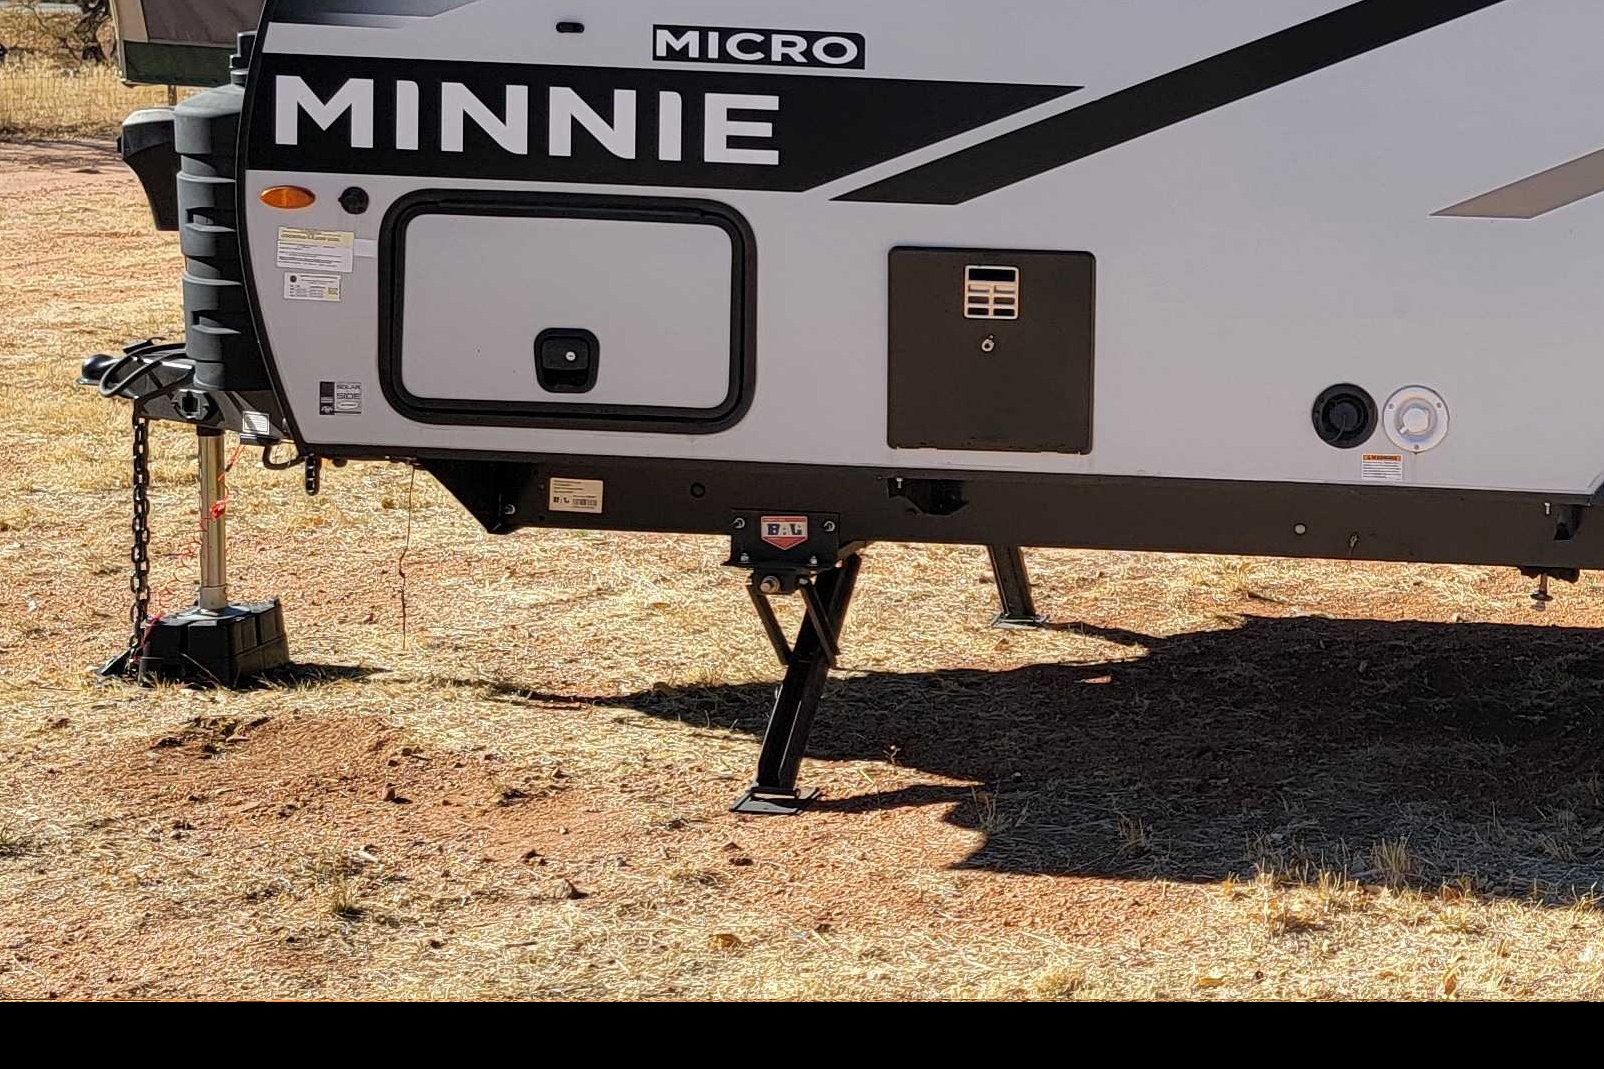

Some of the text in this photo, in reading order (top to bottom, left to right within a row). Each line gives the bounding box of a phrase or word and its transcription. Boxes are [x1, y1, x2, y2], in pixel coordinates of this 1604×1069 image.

[655, 29, 858, 66] MICRO
[275, 74, 780, 165] MINNIE
[336, 392, 361, 400] SIDE
